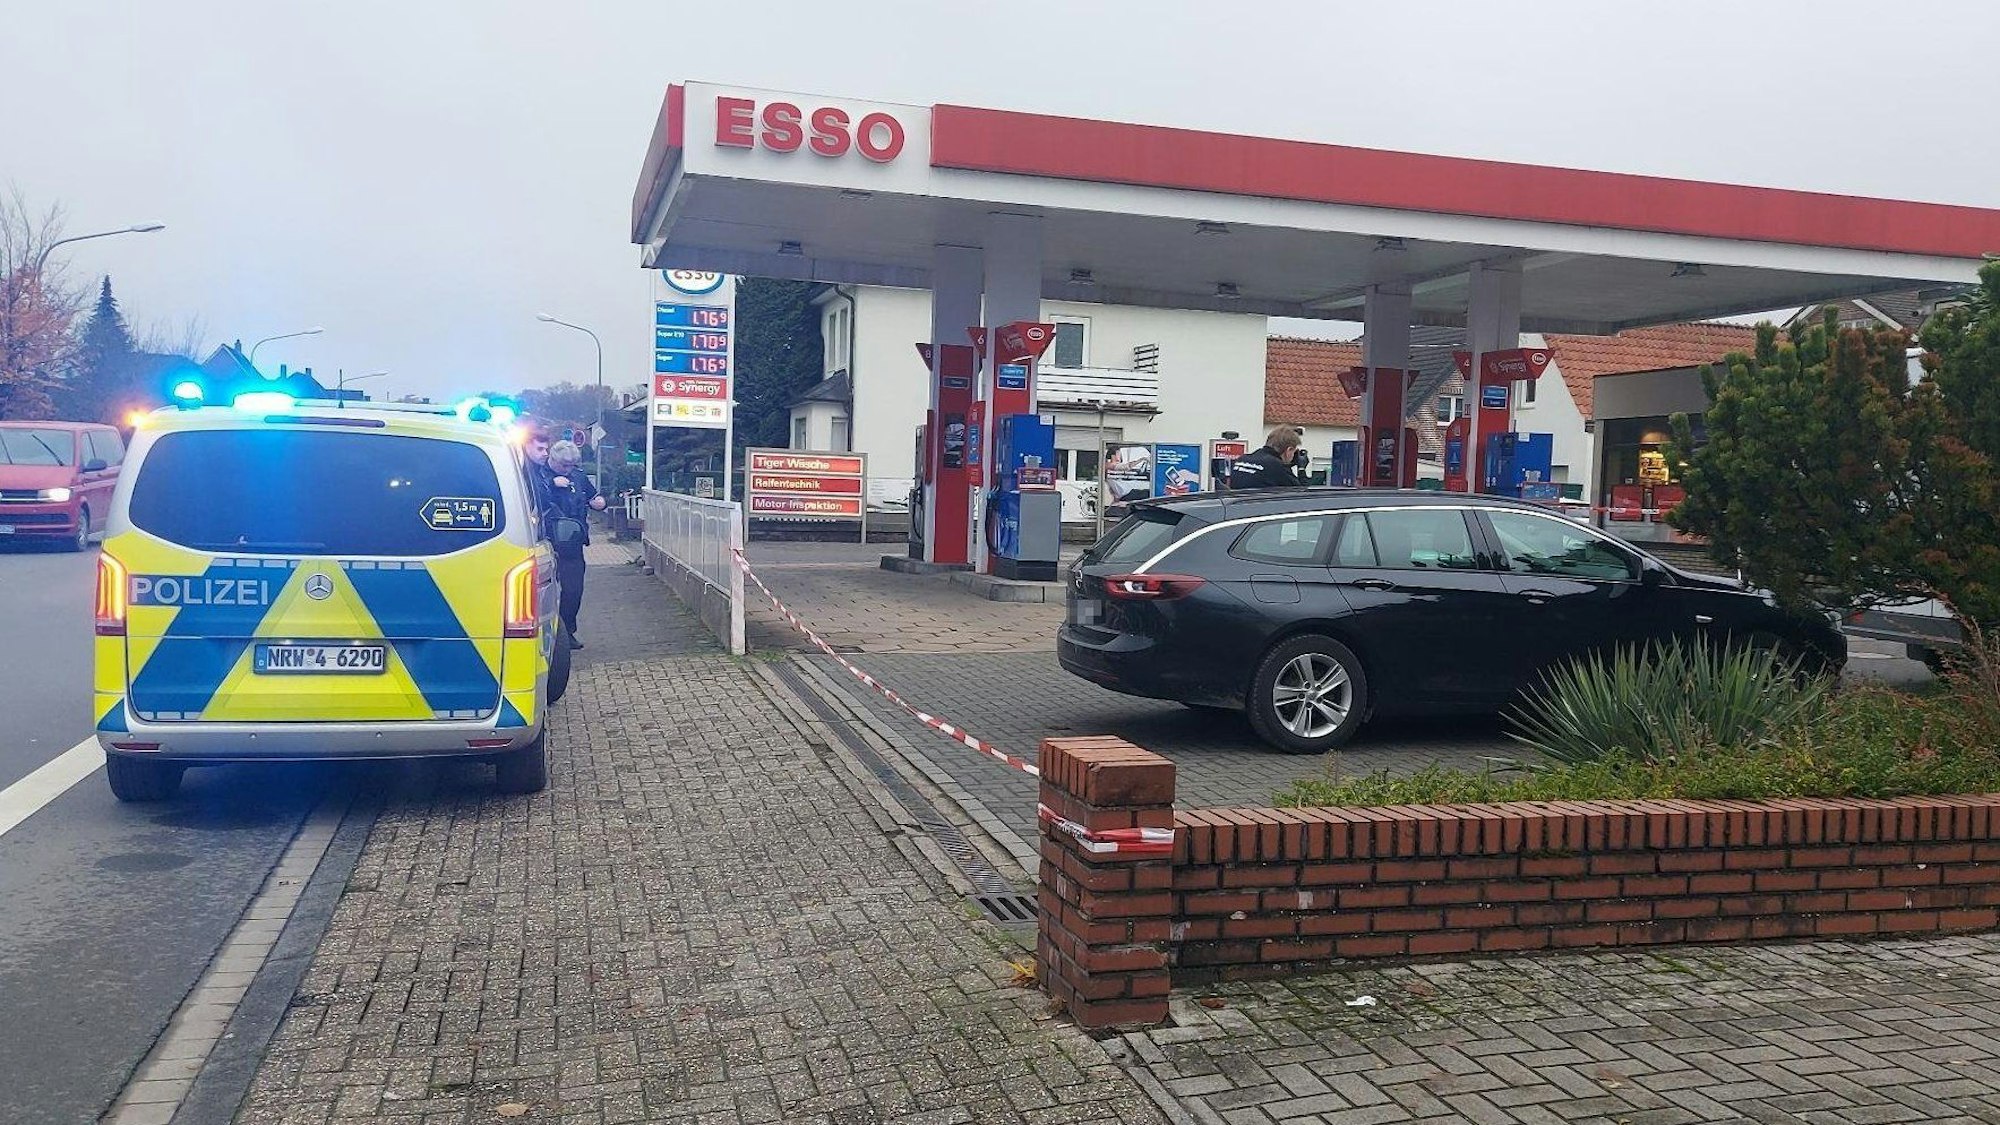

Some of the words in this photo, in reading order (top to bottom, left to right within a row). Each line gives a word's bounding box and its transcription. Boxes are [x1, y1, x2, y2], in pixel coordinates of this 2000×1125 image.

[714, 96, 905, 164] ESSO
[977, 334, 985, 345] 6
[925, 349, 931, 359] 8
[678, 381, 721, 395] Synergy
[756, 457, 784, 468] Tiger
[755, 479, 821, 489] Reifentechnik
[755, 499, 787, 508] Motor
[789, 500, 842, 511] Inspektion
[131, 577, 268, 605] POLIZEI
[268, 649, 304, 667] NRW
